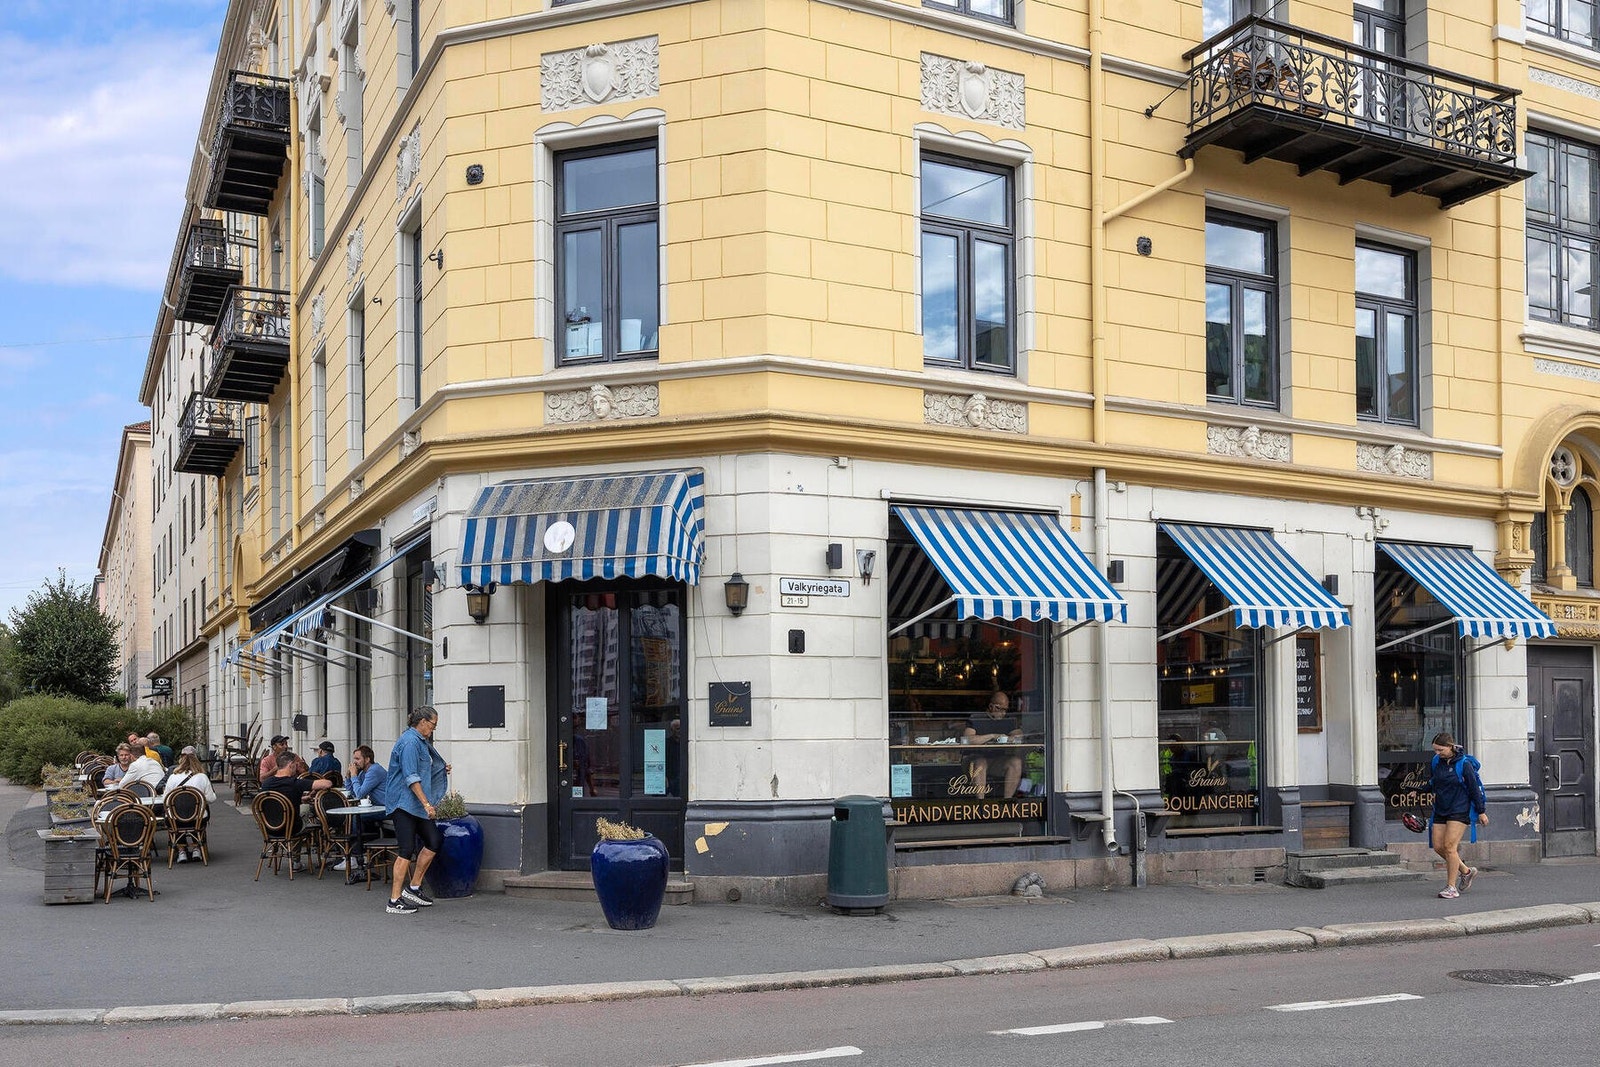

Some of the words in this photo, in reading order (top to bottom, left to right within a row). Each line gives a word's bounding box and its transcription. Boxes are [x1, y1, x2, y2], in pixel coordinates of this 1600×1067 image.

[788, 582, 842, 594] Valkyriegata
[1566, 605, 1575, 618] 21
[948, 775, 992, 795] Grains
[1188, 767, 1228, 787] Grains
[1163, 794, 1254, 811] BOULANGERIE
[897, 802, 1043, 823] HÅNDVERKSBAKERI
